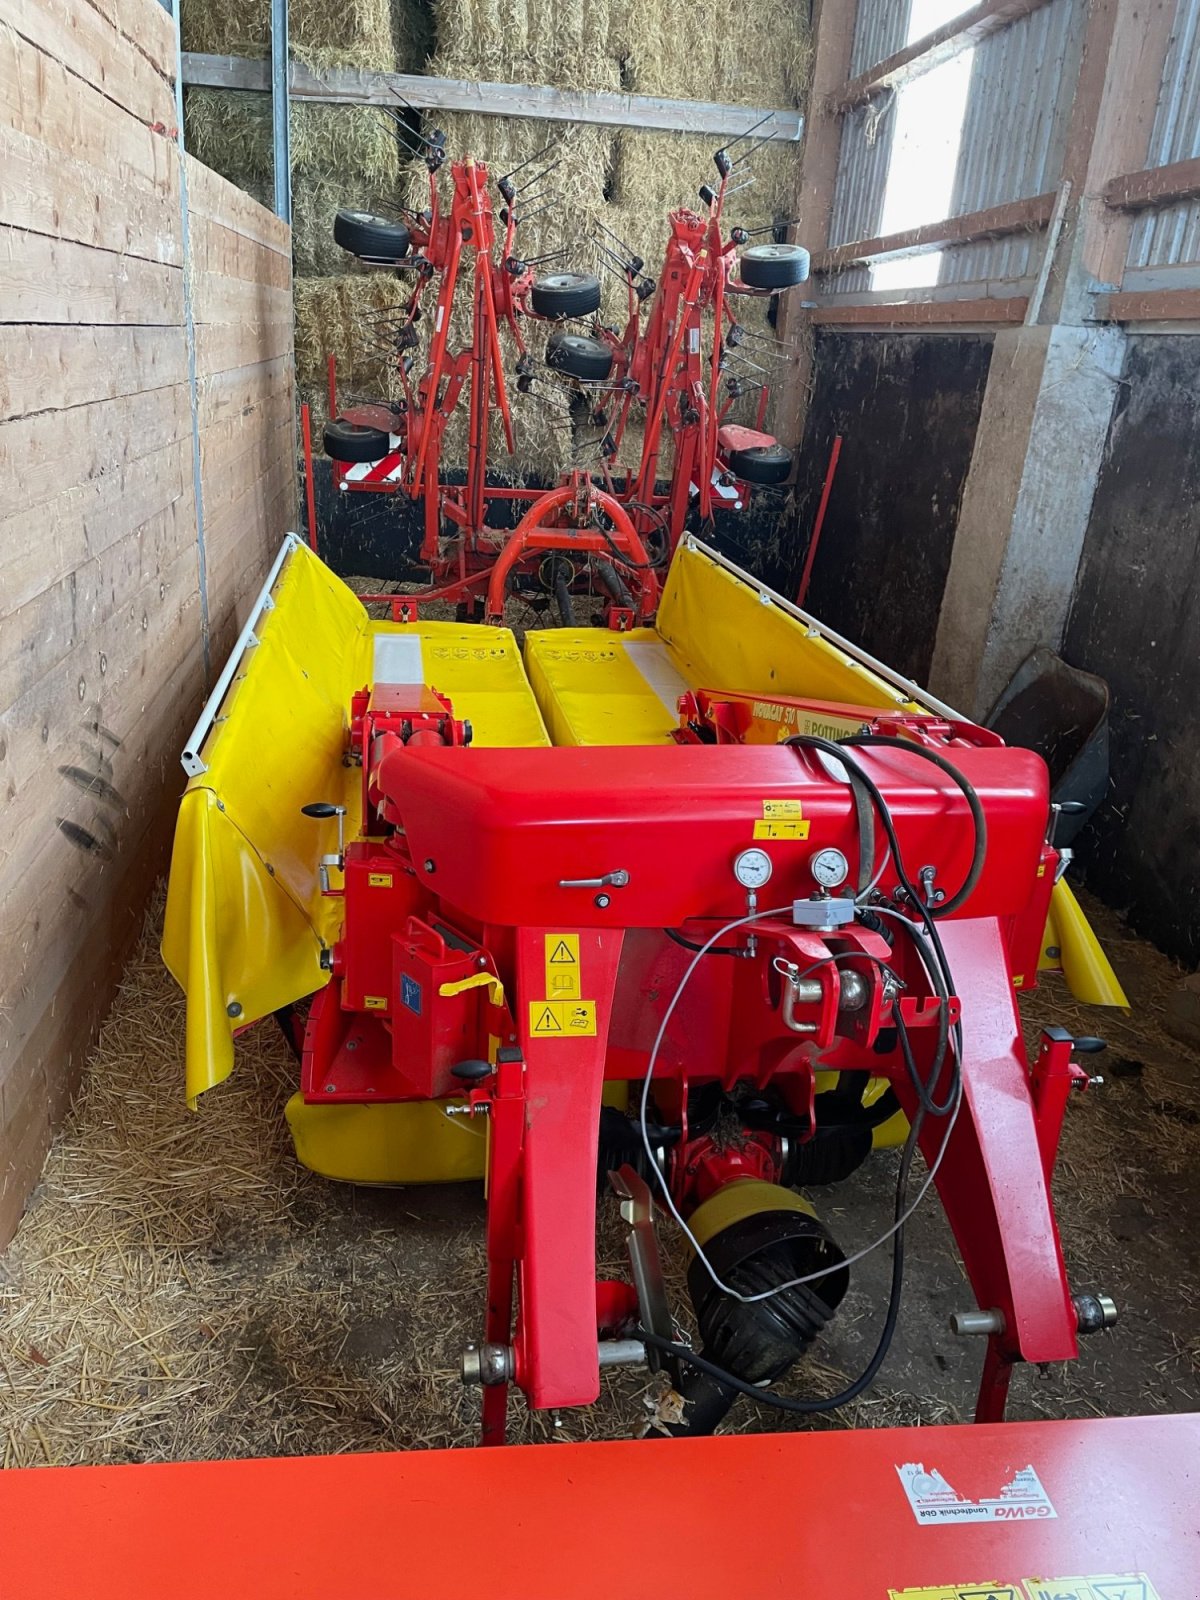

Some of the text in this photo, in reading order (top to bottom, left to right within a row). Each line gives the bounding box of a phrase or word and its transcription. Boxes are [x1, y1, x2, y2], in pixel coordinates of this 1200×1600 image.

[919, 1505, 1051, 1518] GeWa Landtechnik GbR
